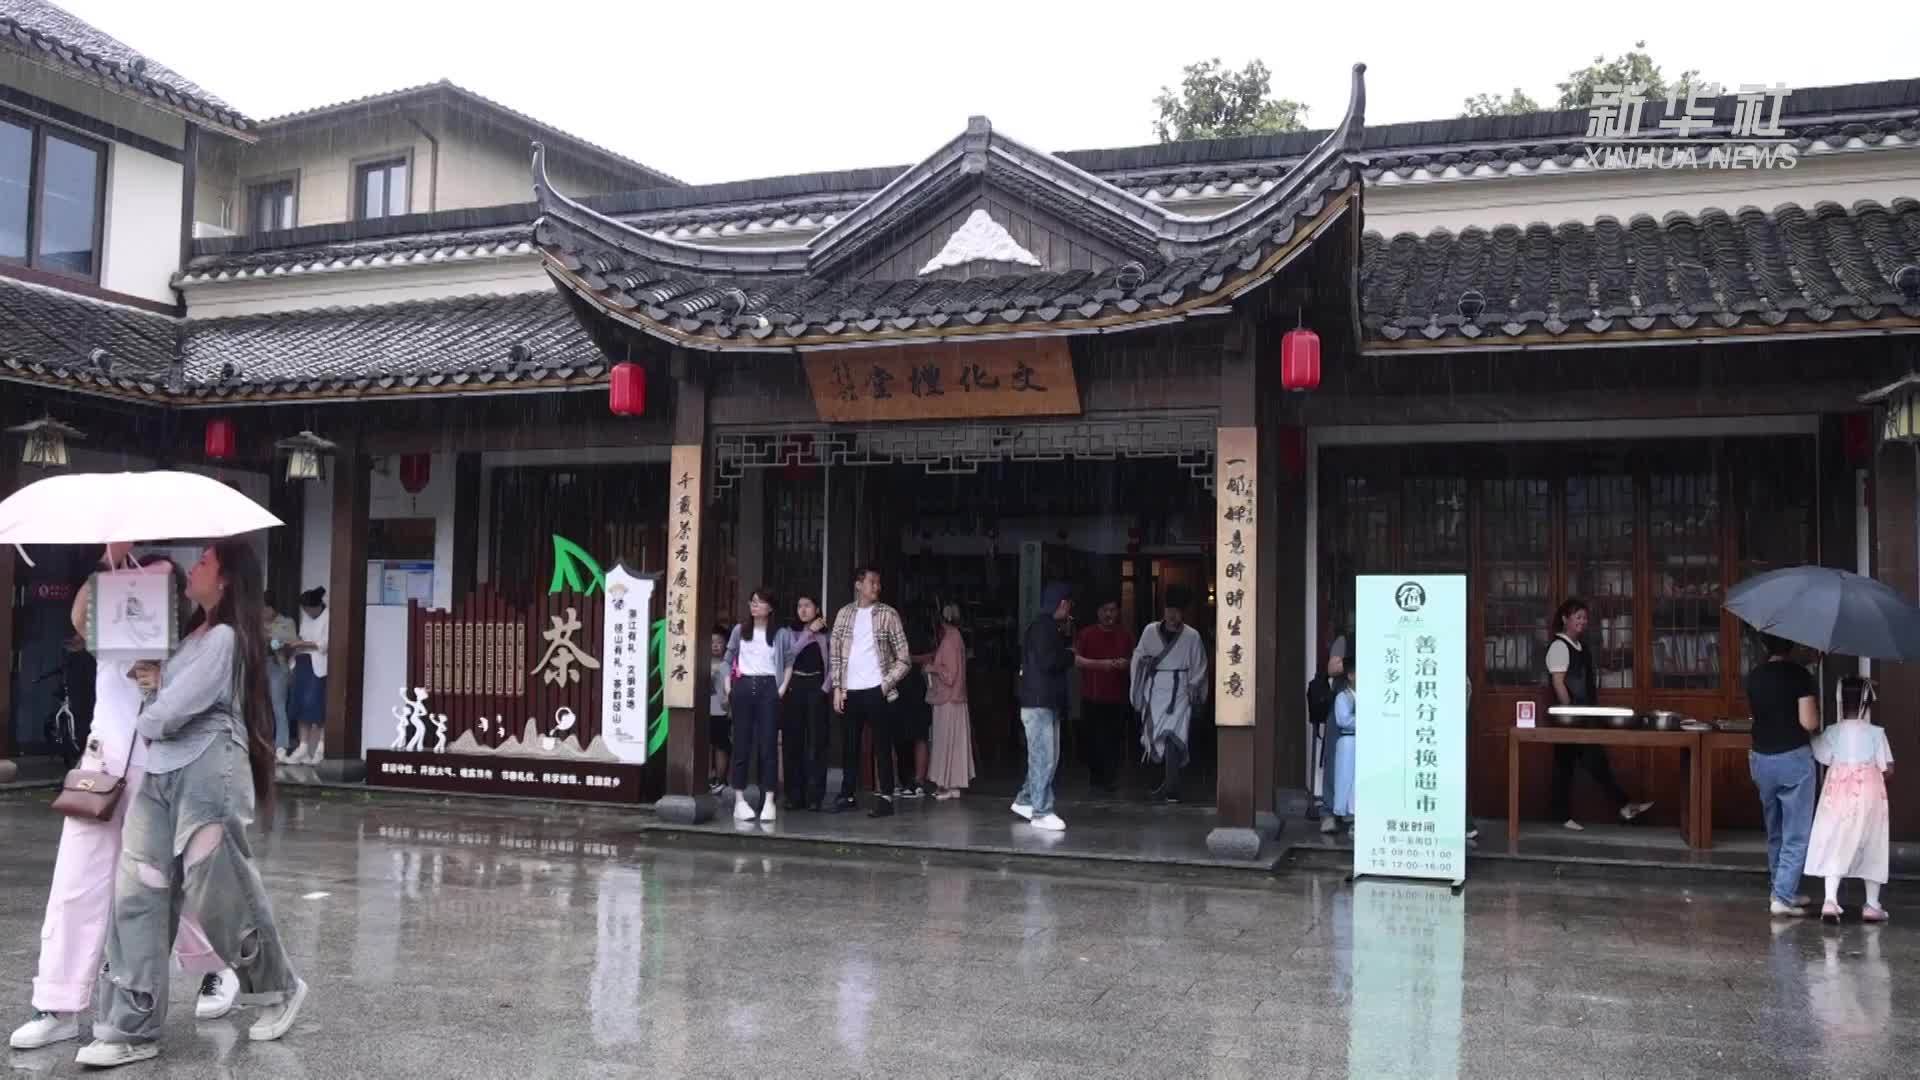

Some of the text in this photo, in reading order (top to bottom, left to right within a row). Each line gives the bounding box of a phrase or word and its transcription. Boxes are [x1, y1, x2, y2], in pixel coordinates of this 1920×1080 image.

[530, 607, 600, 688] 茶
[1414, 634, 1438, 812] 善治积分兑换超市
[1387, 819, 1435, 832] 营业时间
